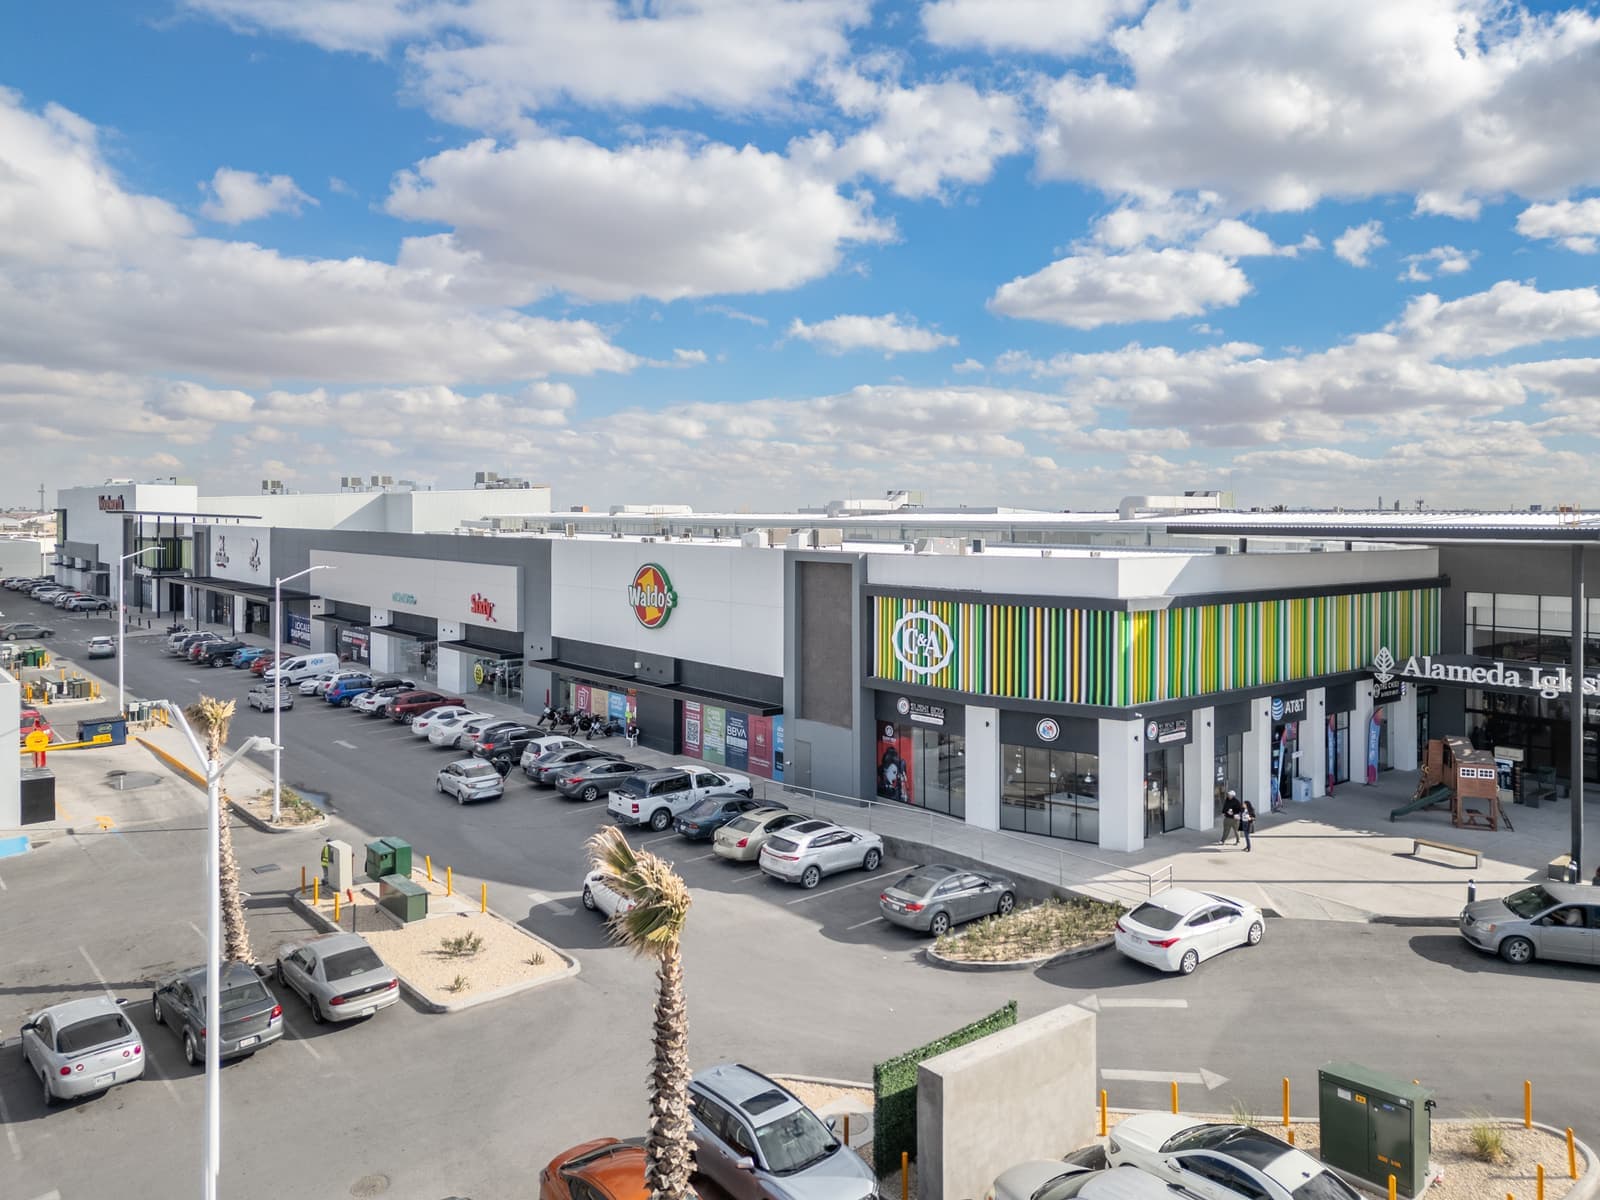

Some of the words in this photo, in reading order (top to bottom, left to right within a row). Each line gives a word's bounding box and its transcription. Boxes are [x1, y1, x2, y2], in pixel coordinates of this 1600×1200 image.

[629, 585, 673, 608] Waldo's
[905, 628, 943, 658] C&A
[1400, 656, 1521, 688] Alameda
[1529, 667, 1600, 699] Iglsi
[1285, 699, 1305, 714] AT&T
[727, 725, 747, 738] BBVA
